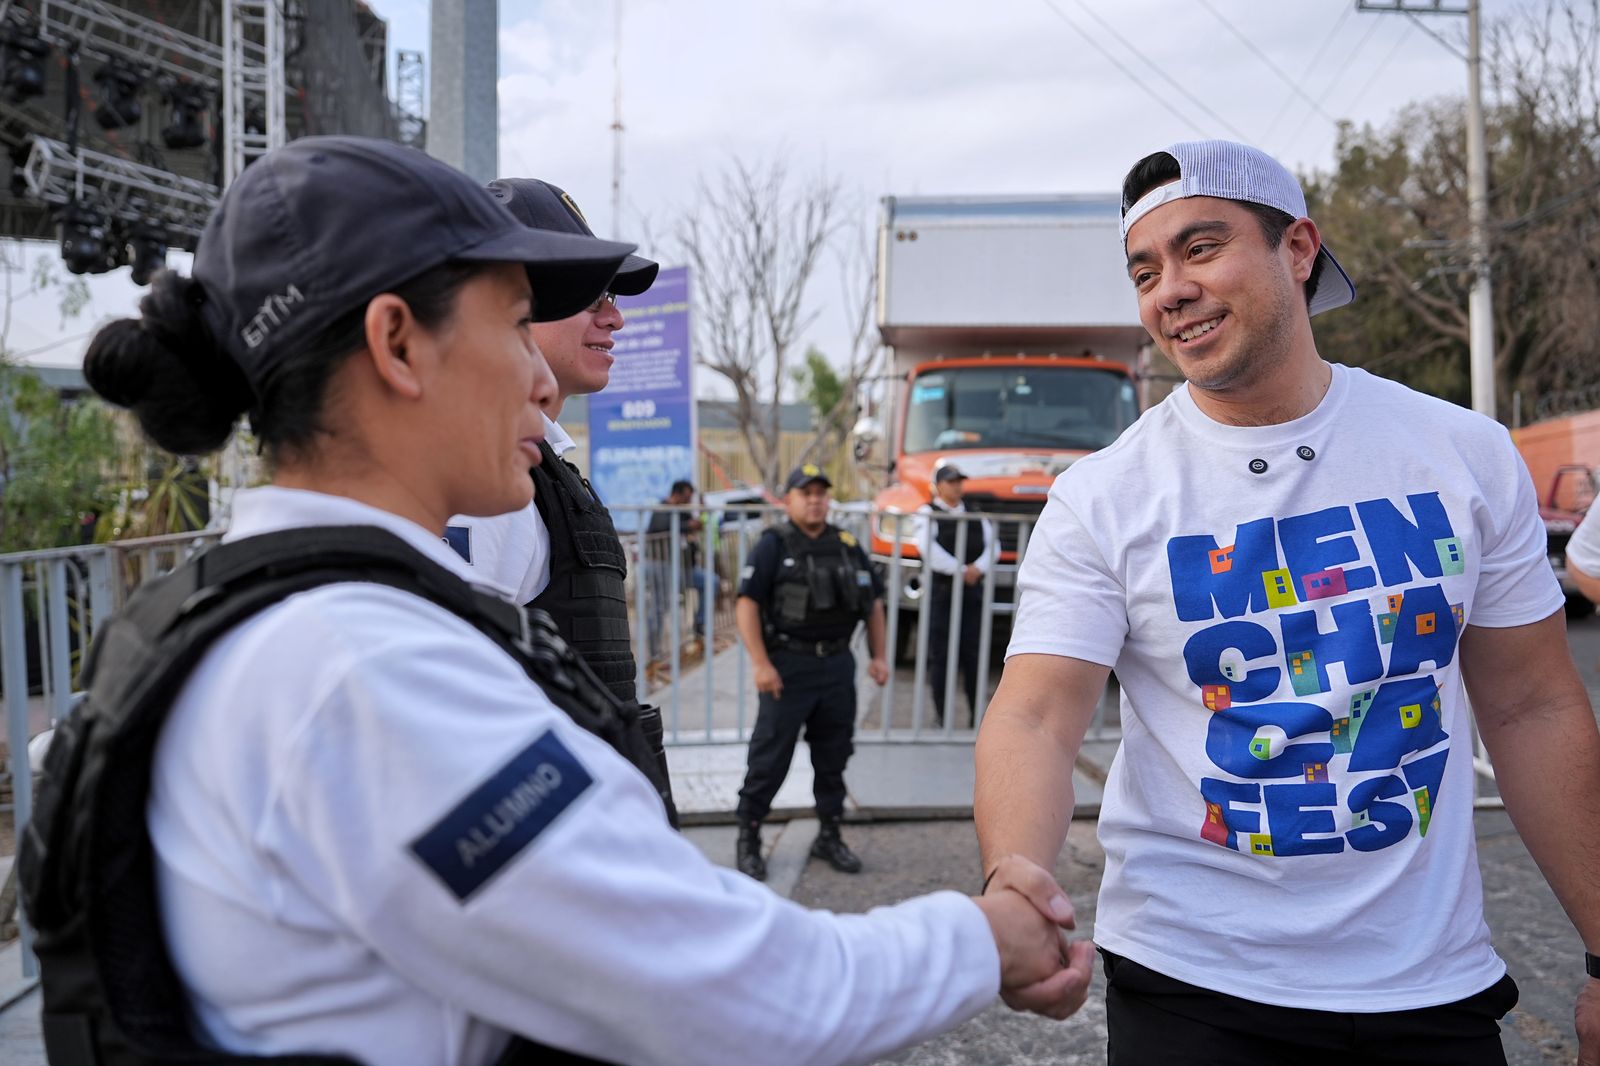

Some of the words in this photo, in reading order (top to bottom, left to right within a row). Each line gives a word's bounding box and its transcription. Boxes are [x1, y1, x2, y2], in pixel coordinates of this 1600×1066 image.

[1167, 491, 1464, 622] MEN
[1183, 583, 1462, 706] CHA
[1205, 675, 1450, 781] CA
[455, 762, 563, 869] ALUMNO
